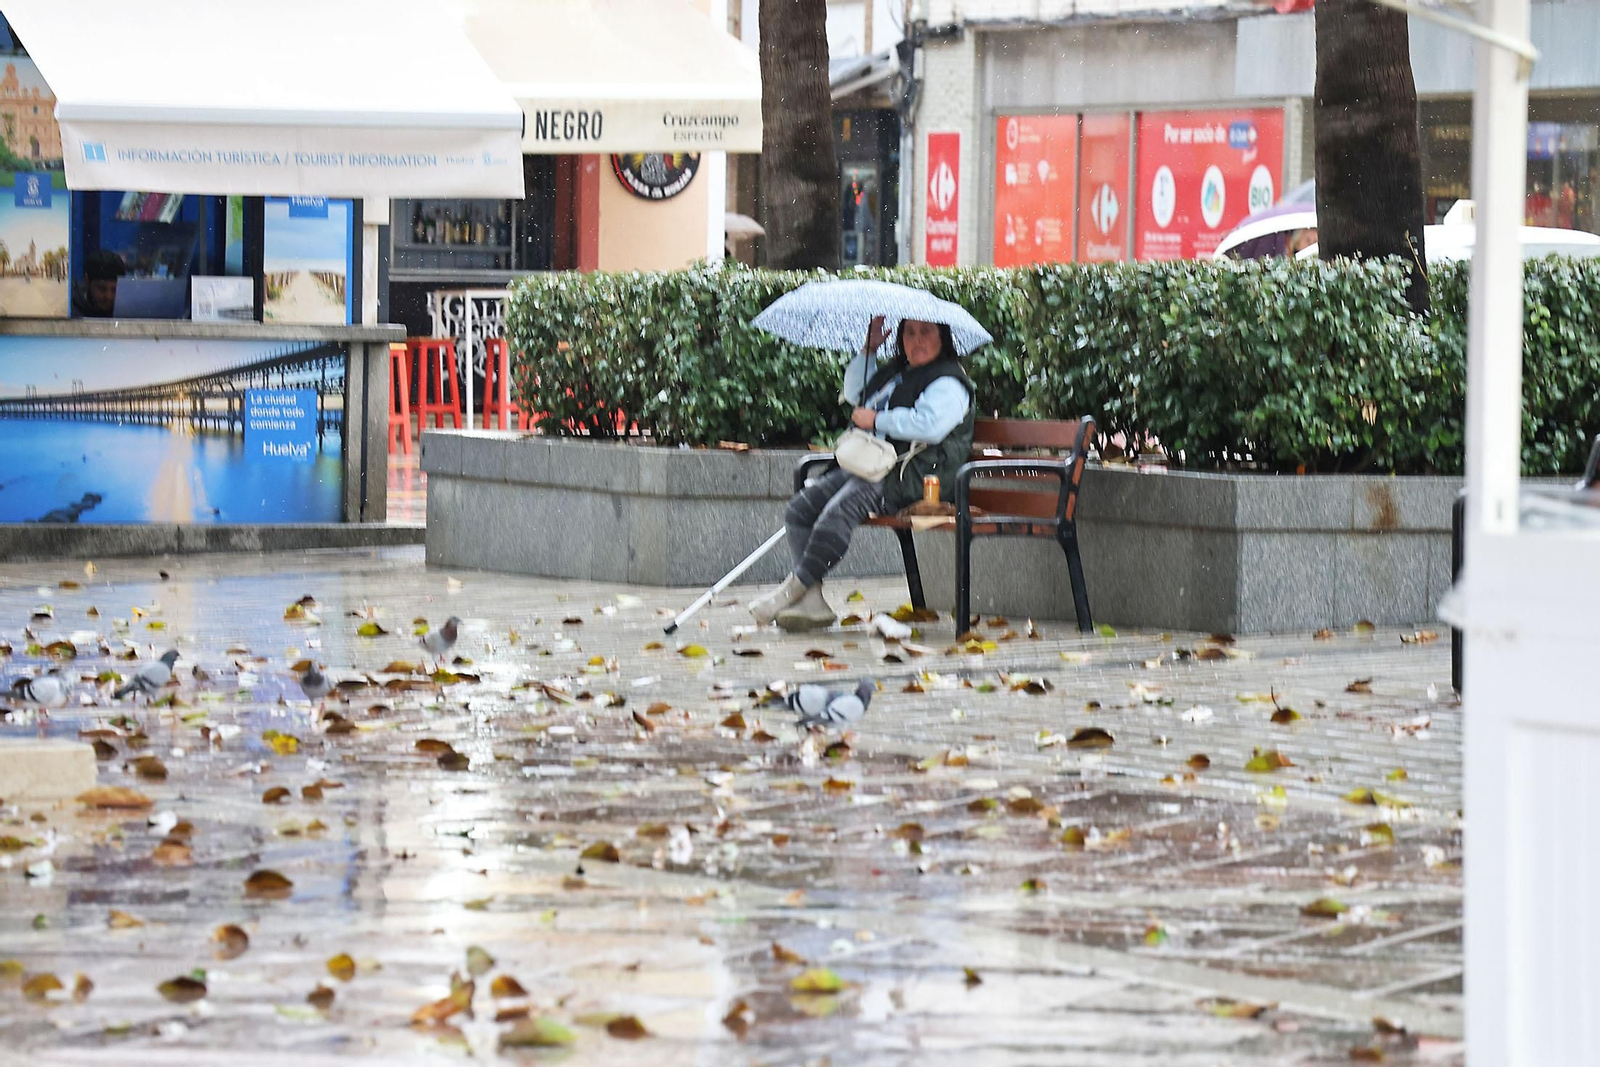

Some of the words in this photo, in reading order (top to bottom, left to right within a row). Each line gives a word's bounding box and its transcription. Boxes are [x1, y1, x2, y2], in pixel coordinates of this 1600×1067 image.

[535, 110, 603, 140] NEGRO
[663, 111, 739, 129] Cruzcampo
[673, 131, 723, 141] ESPECIAL
[117, 147, 212, 164] INFORMACIÓN
[216, 149, 281, 165] TURÍSTICA
[294, 152, 345, 167] TOURIST
[350, 153, 437, 167] INFORMATION
[1251, 187, 1270, 207] BIO
[250, 393, 263, 405] La
[264, 393, 297, 405] ciudad
[250, 406, 280, 418] donde
[282, 406, 305, 418] todo
[250, 419, 296, 431] comienza
[263, 441, 309, 457] Huelva
